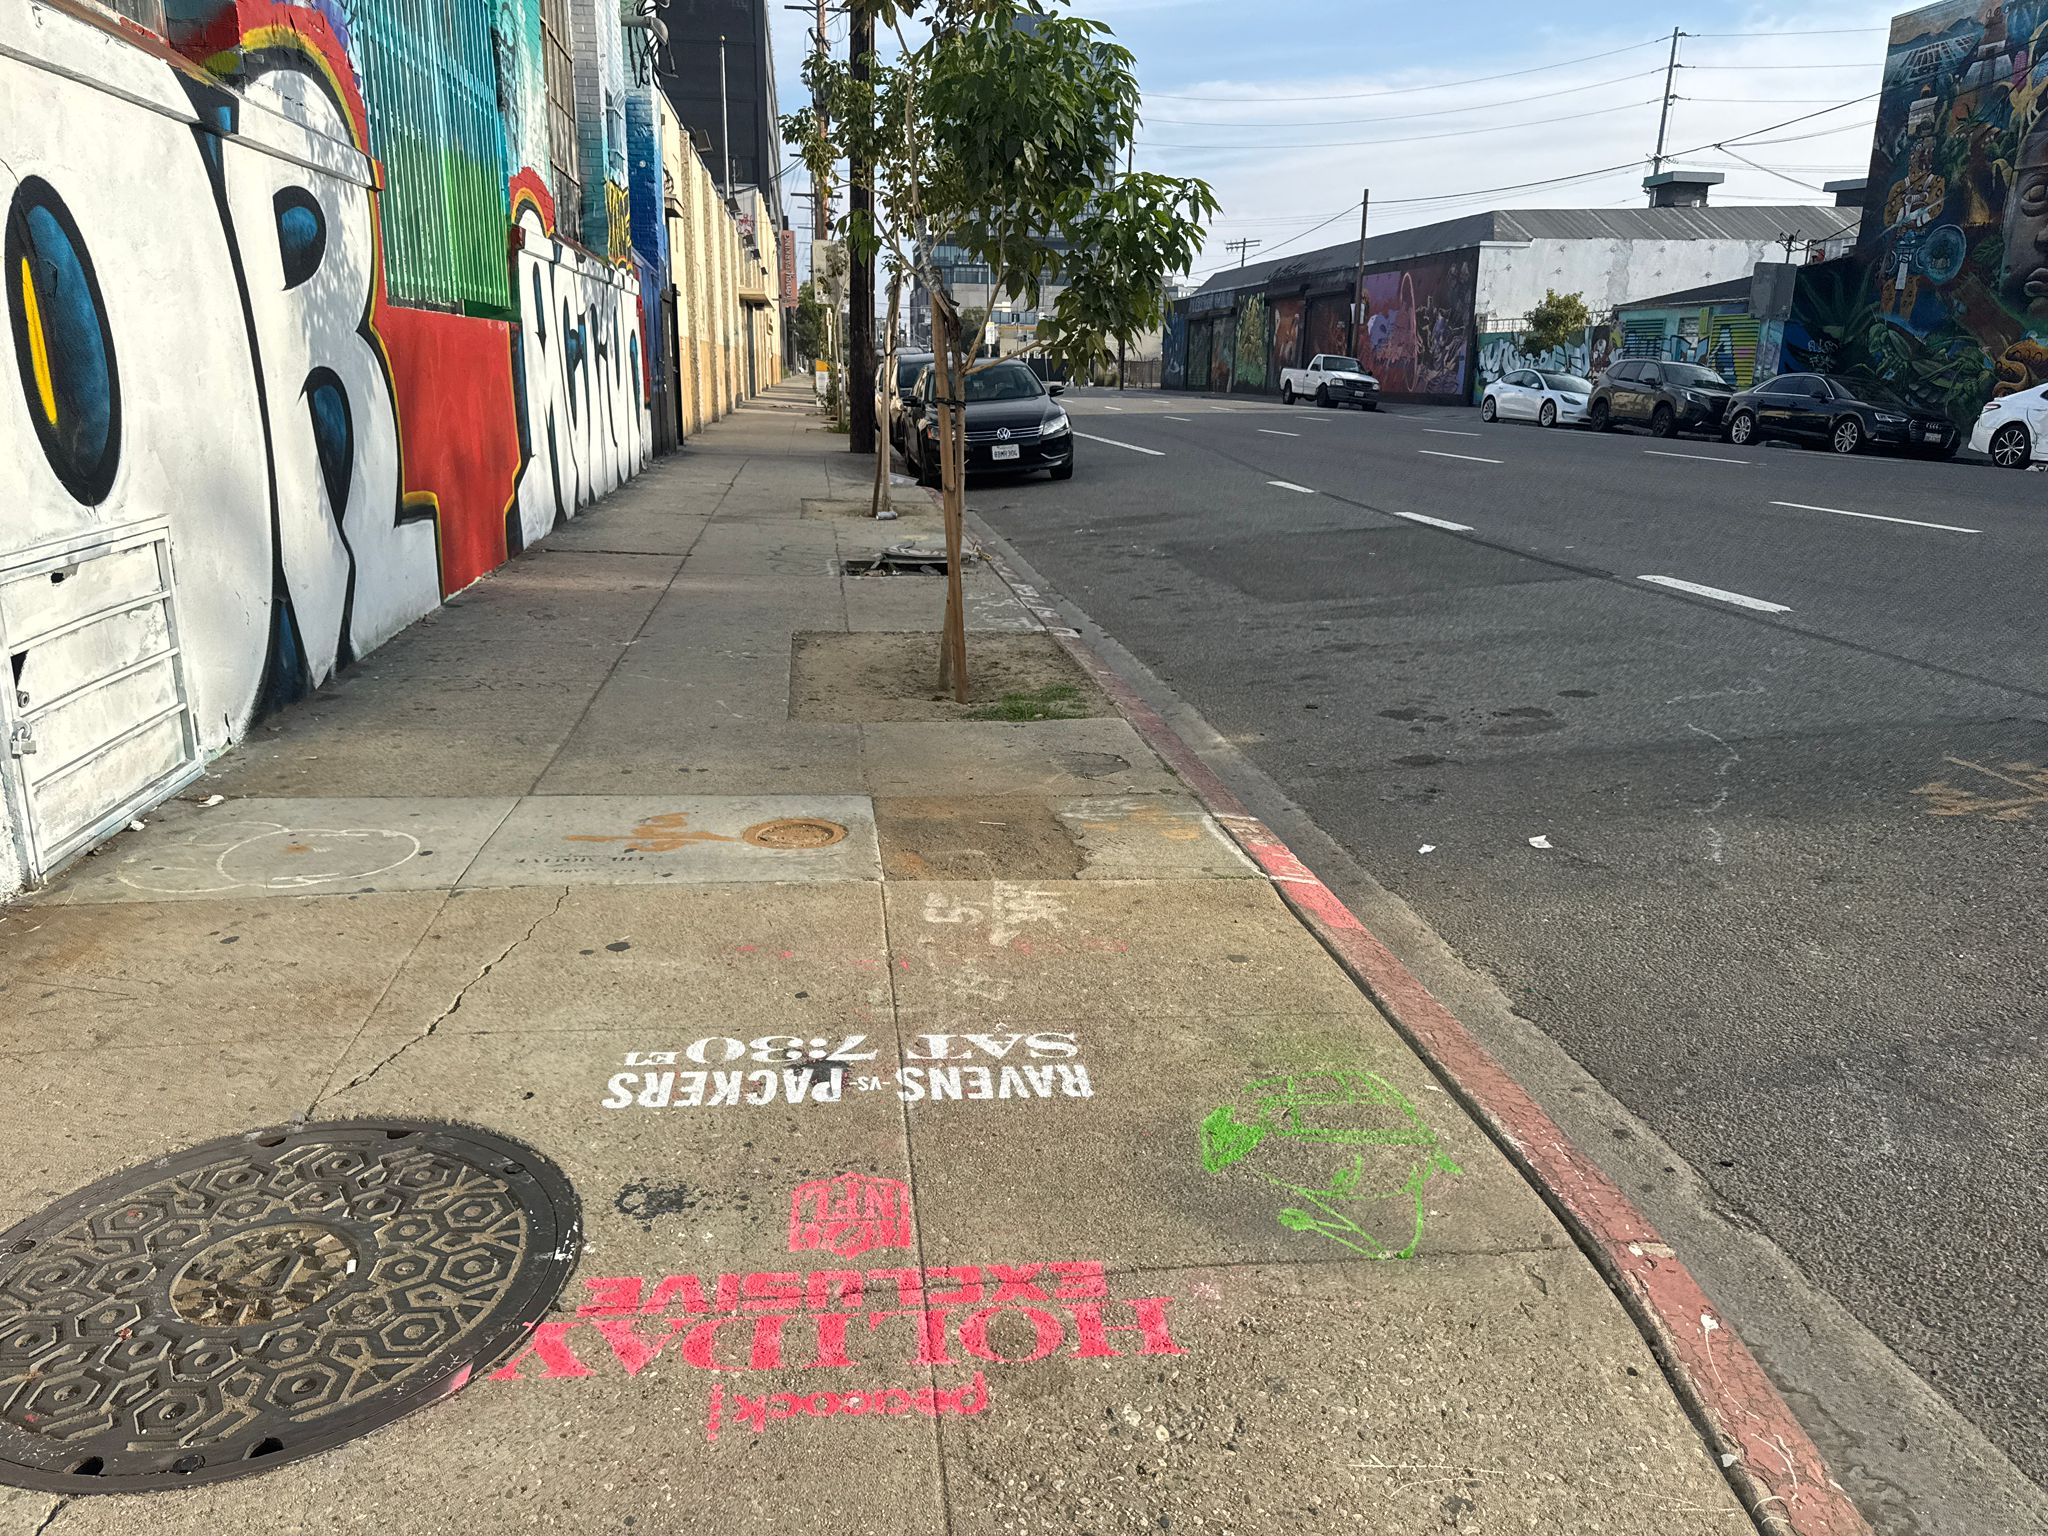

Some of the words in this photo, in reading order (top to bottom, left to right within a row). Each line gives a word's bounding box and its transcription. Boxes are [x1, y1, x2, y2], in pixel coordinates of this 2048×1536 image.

[620, 1051, 681, 1066] ET
[685, 1034, 879, 1064] 7:30
[906, 1032, 1078, 1059] SAT
[601, 1068, 843, 1109] PACKERS
[896, 1064, 1095, 1101] RAVENS
[801, 1184, 897, 1219] NFL
[576, 1261, 1108, 1317] EXCLUSIVE
[488, 1297, 1190, 1380] HOLIDAY
